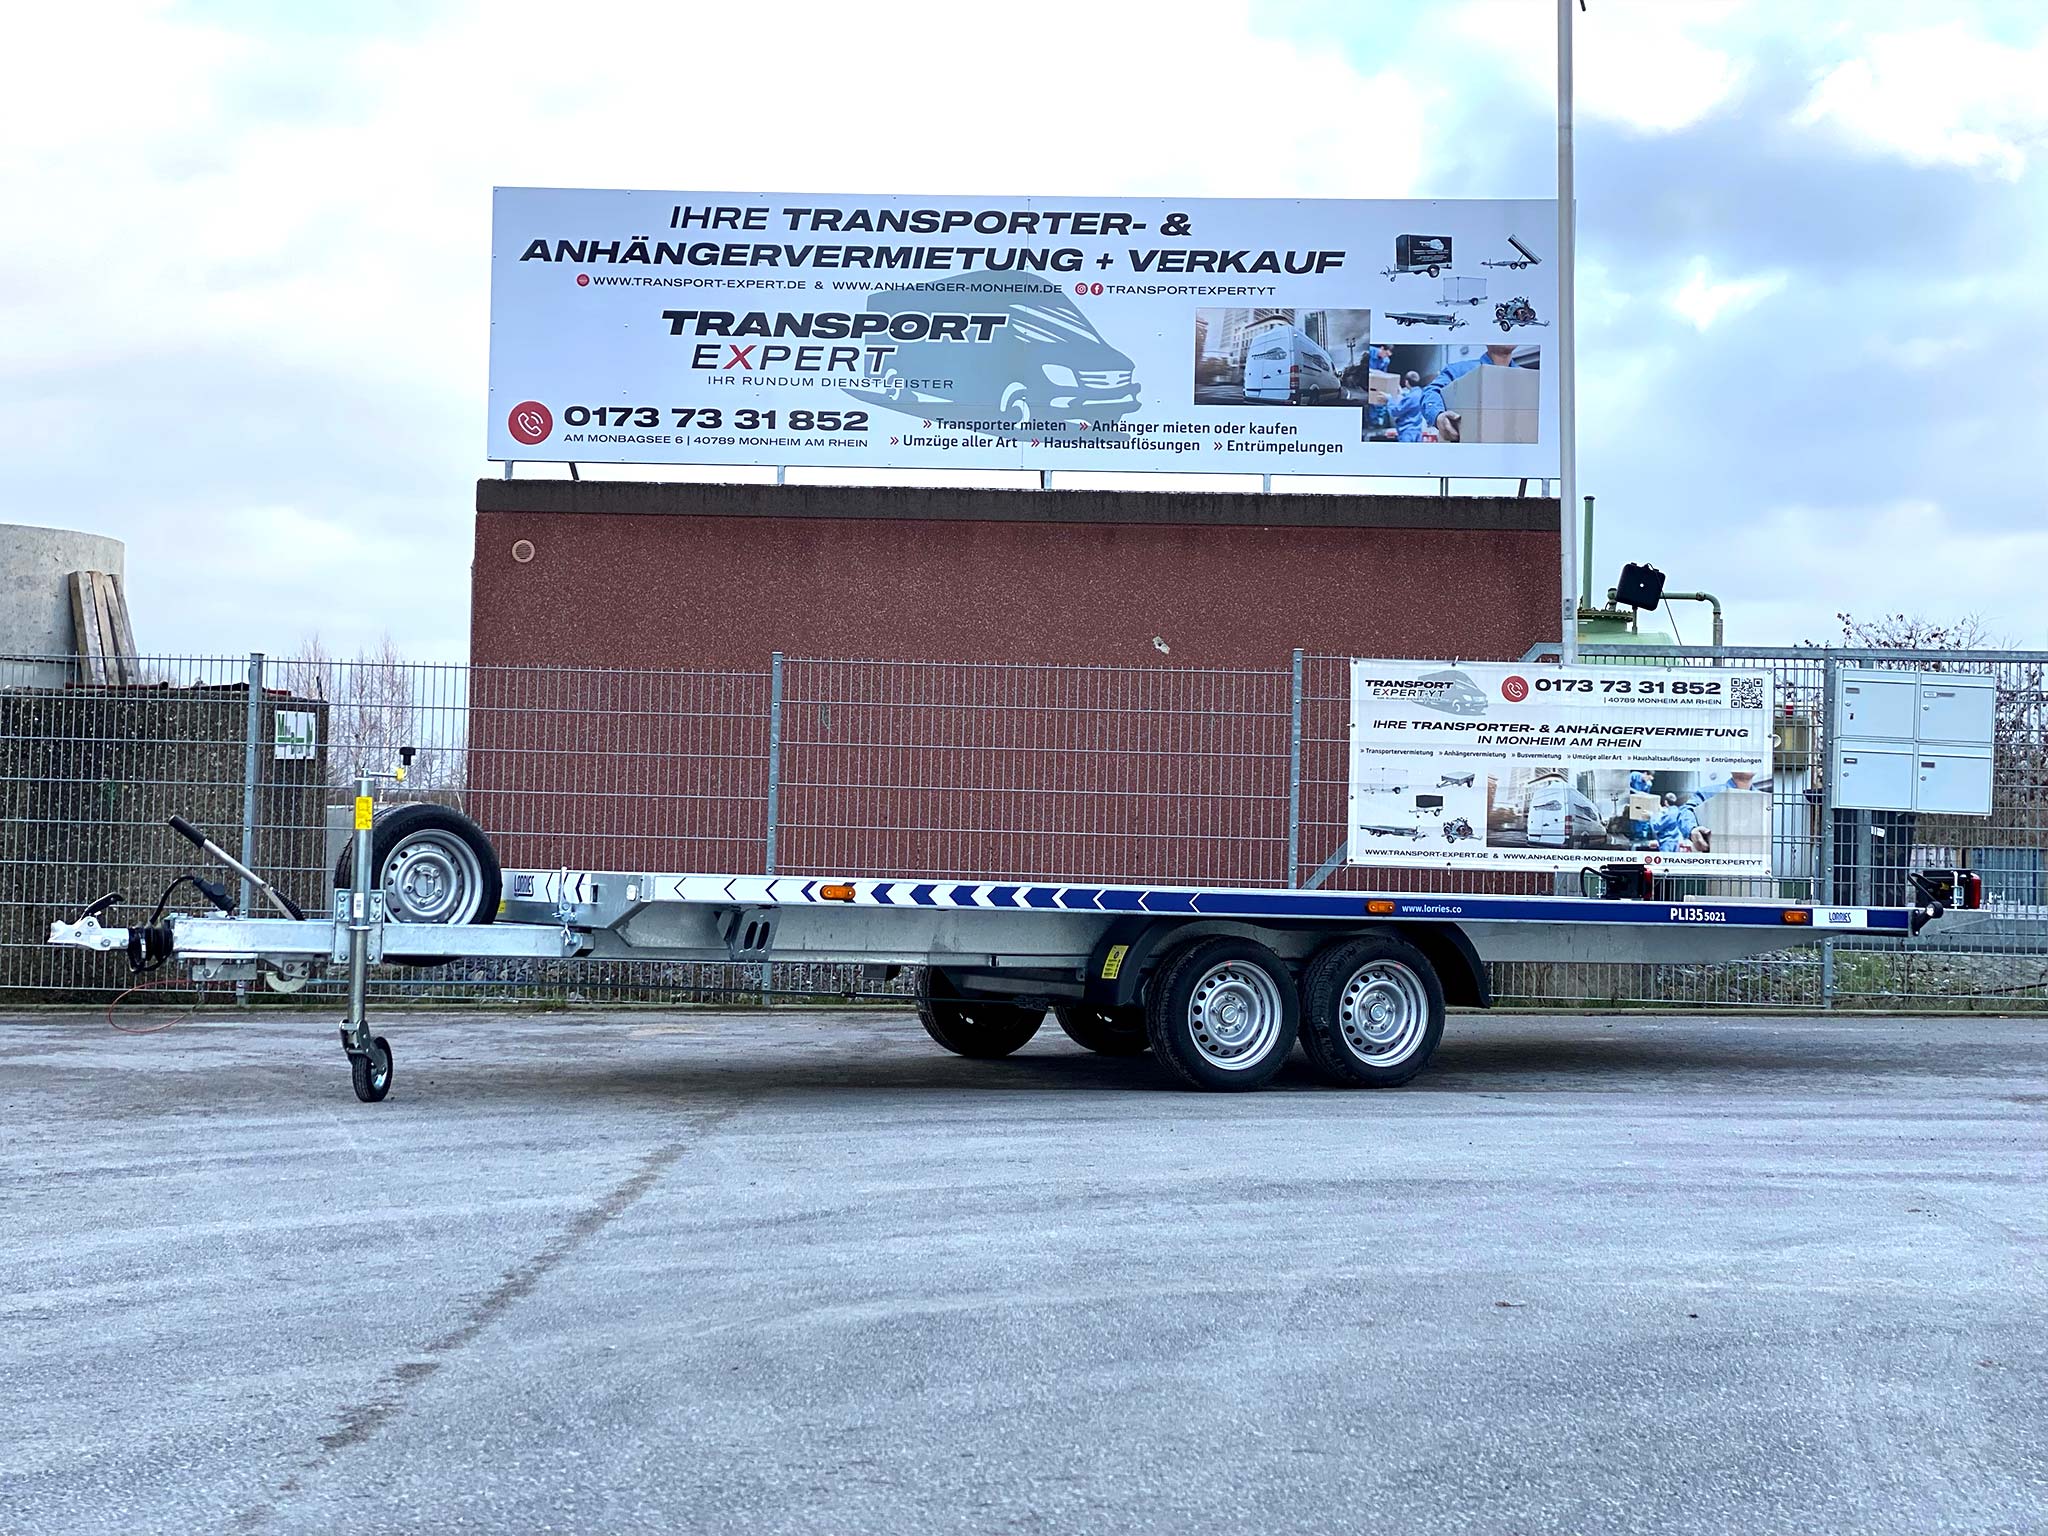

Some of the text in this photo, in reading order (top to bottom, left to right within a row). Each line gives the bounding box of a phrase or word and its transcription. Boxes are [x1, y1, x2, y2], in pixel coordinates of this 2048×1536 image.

[670, 206, 1192, 236] IHRE TRANSPORTER- &
[520, 236, 1346, 274] ANHÄNGERVERMIETUNG + VERKAUF
[593, 276, 1062, 294] WWW.TRANSPORT-EXPERT.DE & WWW.ANHAENGER-MONHEIM.DE
[1107, 286, 1276, 296] TRANSPORTEXPERTYT
[662, 310, 1007, 342] TRANSPORT
[692, 344, 896, 373] EXPERT
[708, 377, 953, 389] IHR RUNDUM DIENSTLEISTER
[564, 406, 869, 431] 0173 73 31 852
[936, 418, 1066, 433] Transporter mieten
[1092, 420, 1298, 437] Anhänger mieten oder kaufen
[564, 435, 585, 443] AM
[588, 435, 671, 444] MONBAGSEE
[675, 437, 683, 445] 6
[693, 436, 735, 446] 40789
[739, 437, 800, 446] MONHEIM
[804, 438, 824, 447] AM
[828, 439, 868, 448] RHEIN
[903, 435, 1018, 450] Umzüge aller Art
[1044, 436, 1200, 452] Haushaltsauflösungen
[1227, 439, 1343, 454] Entrümpelungen
[1365, 680, 1454, 688] TRANSPORT
[1535, 679, 1721, 695] 0173 73 31 852
[1373, 720, 1749, 738] IHRE TRANSPORTER- & ANHÄNGERVERMIETUNG
[1477, 735, 1642, 748] IN MONHEIM AM RHEIN
[1366, 748, 1433, 756] Transportervermietung
[1444, 750, 1506, 758] Anhängervermietung
[1517, 752, 1561, 760] Busvermietung
[1365, 849, 1488, 859] WWW.TRANSPORT-EXPERT.DE
[1503, 853, 1637, 863] WWW.ANHAENGER-MONHEIM.DE
[1663, 858, 1762, 866] TRANSPORTEXPERTYT
[1401, 904, 1462, 913] www.lorries.co
